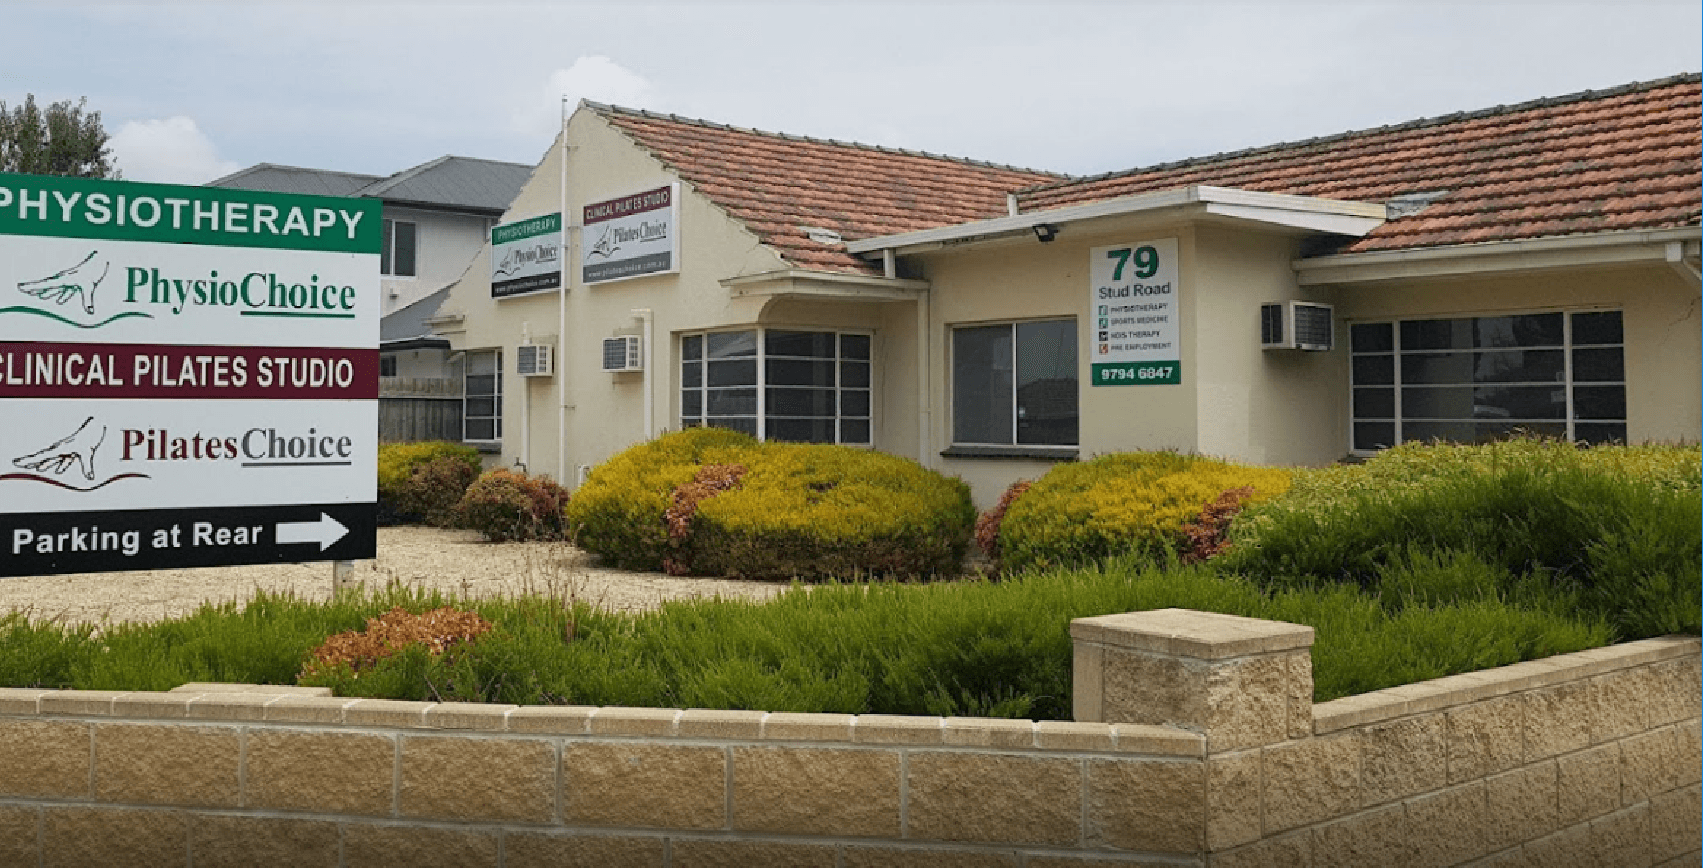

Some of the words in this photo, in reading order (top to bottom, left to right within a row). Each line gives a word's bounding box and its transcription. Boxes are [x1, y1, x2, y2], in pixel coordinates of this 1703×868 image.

[586, 203, 613, 220] CLINICAL
[615, 196, 642, 213] PILATES
[643, 190, 668, 207] STUDIO
[497, 217, 556, 241] PHYSIOTHERAPY
[613, 219, 667, 245] PilatesChoice
[514, 244, 559, 267] PhysioChoice
[1107, 244, 1160, 281] 79
[124, 266, 356, 316] PhysioChoice
[1098, 284, 1130, 299] Stud
[1133, 282, 1172, 297] Road
[1110, 303, 1169, 315] PHYSIOTHERAPY
[1110, 316, 1135, 326] SPORTS
[1136, 314, 1169, 325] MEDICINE
[1128, 329, 1161, 339] THERAPY
[1110, 343, 1123, 352] PRE
[1124, 342, 1172, 351] EMPLOYMENT
[0, 352, 123, 386] LINICAL
[133, 354, 248, 388] PILATES
[256, 356, 354, 388] STUDIO
[1101, 368, 1135, 380] 9794
[1137, 366, 1173, 380] 6847
[120, 427, 352, 462] PilatesChoice
[12, 525, 140, 556] Parking
[151, 524, 181, 548] at
[192, 521, 263, 546] Rear
